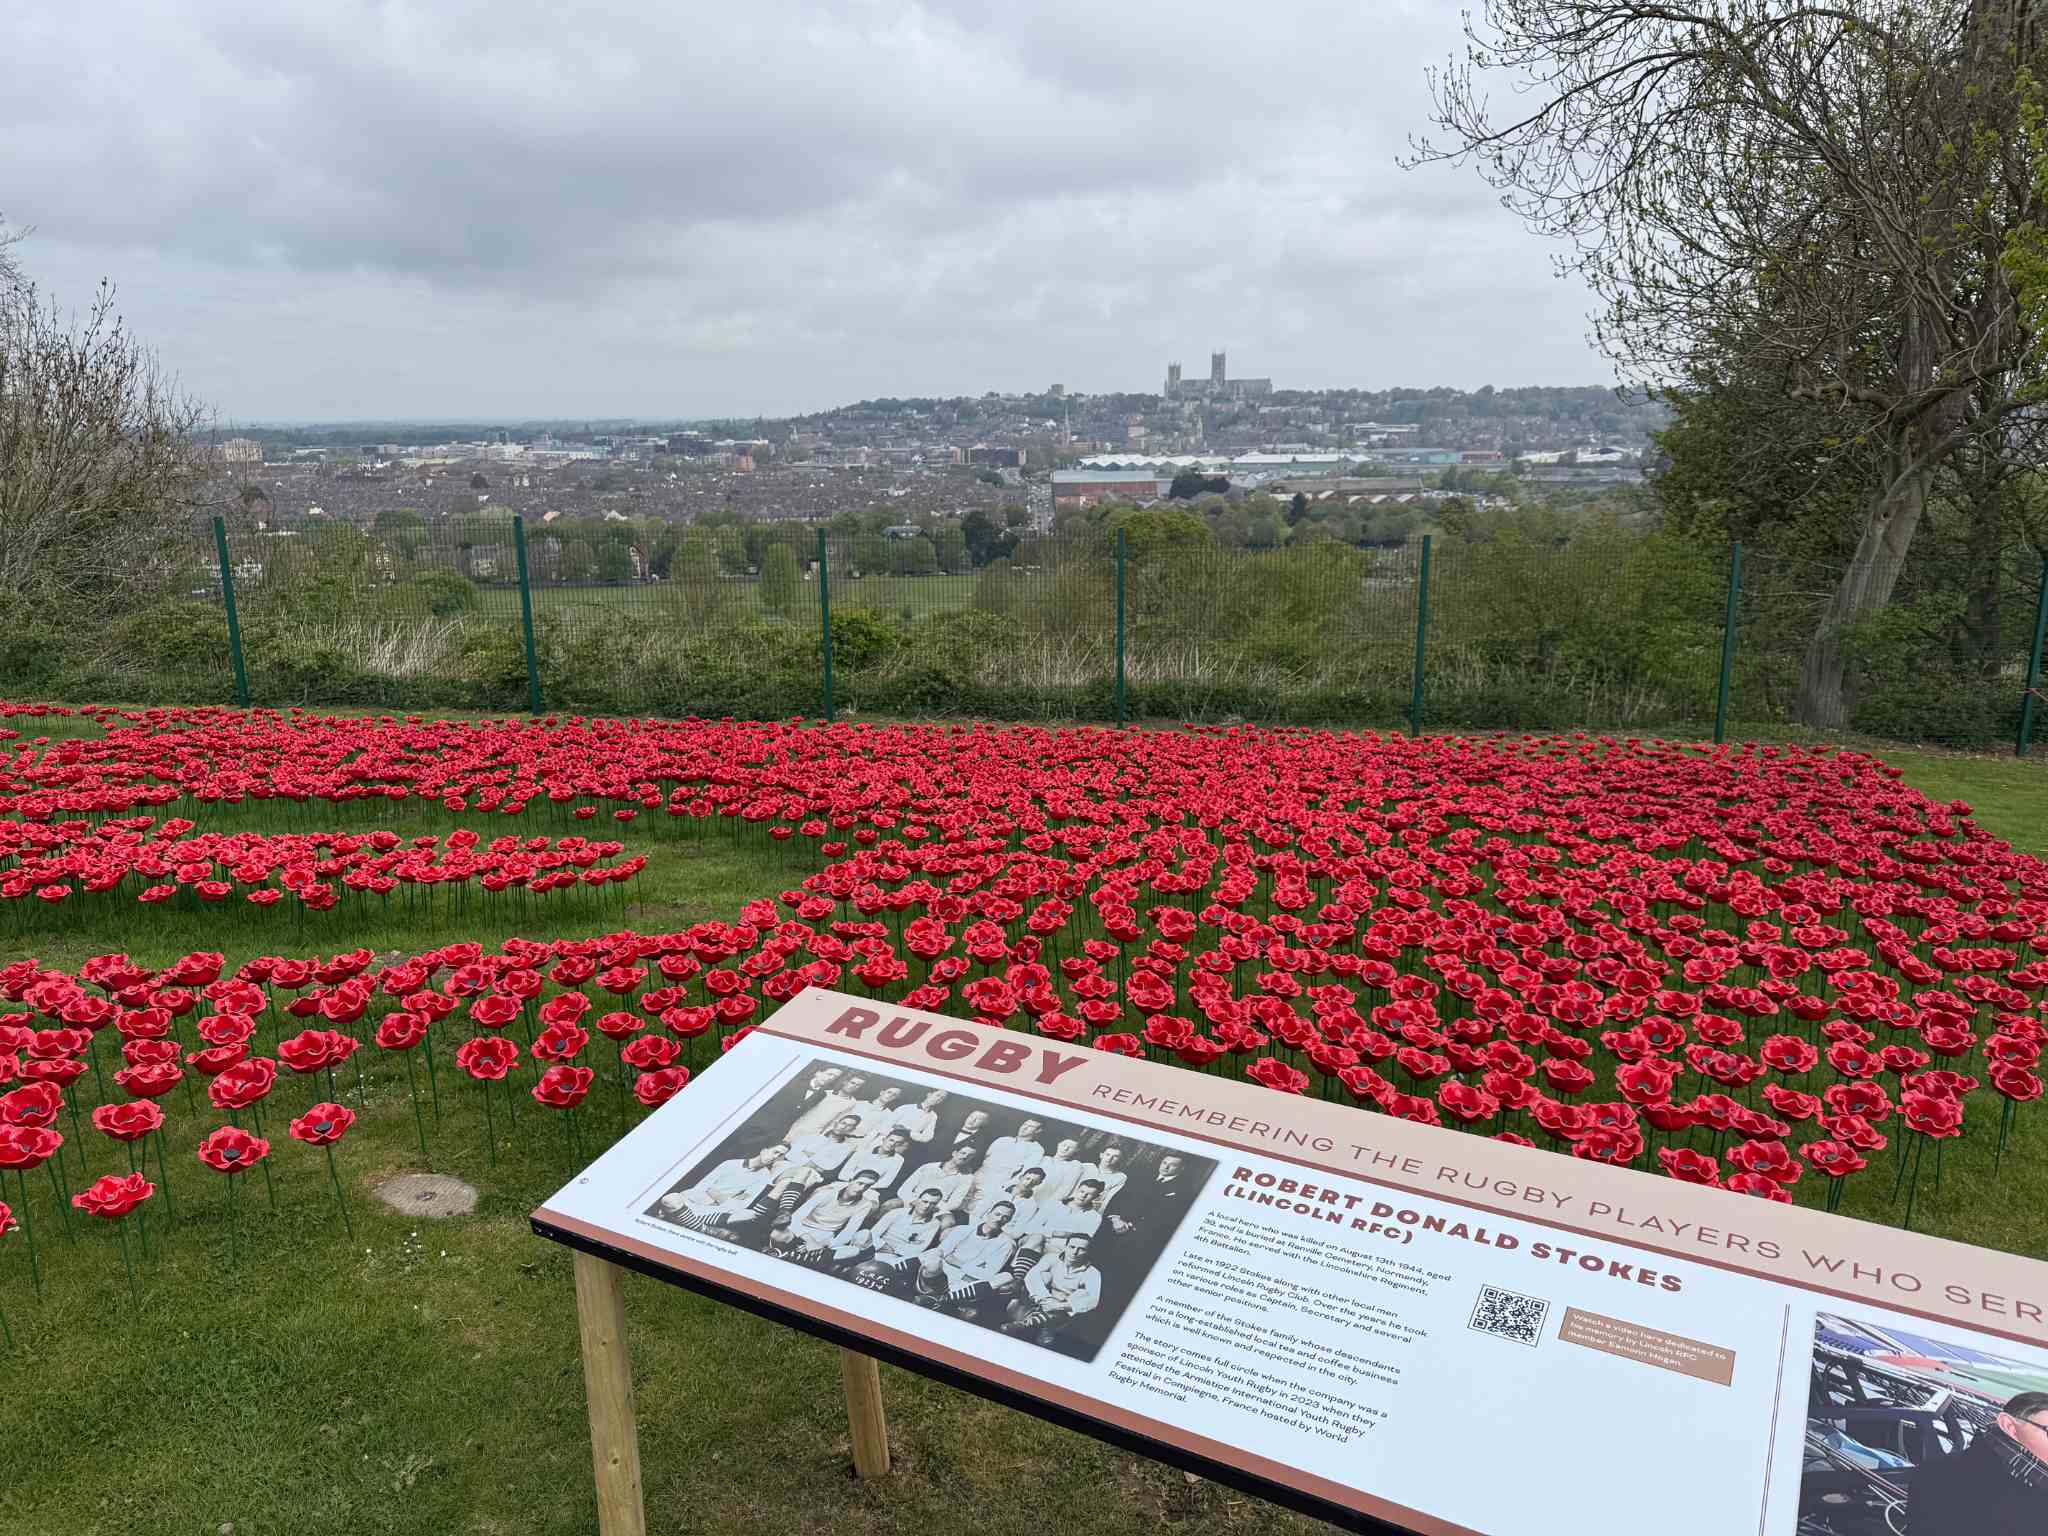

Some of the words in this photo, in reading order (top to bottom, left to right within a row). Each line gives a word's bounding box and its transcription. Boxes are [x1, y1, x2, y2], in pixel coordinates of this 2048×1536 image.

[823, 1006, 1089, 1086] RUGBY
[1091, 1084, 1334, 1152] REMEMBERING
[1351, 1144, 1424, 1175] THE
[1436, 1166, 1573, 1209] RUGBY
[1588, 1201, 1781, 1259] PLAYERS
[1801, 1249, 1922, 1293] WHO
[1944, 1284, 2043, 1324] SER
[1215, 1211, 1239, 1222] local
[1260, 1225, 1280, 1235] who
[1280, 1230, 1299, 1240] was
[1299, 1234, 1326, 1247] killed
[1324, 1243, 1338, 1251] on
[1338, 1246, 1373, 1261] August
[1374, 1255, 1396, 1267] 13th
[1425, 1270, 1452, 1282] aged
[1217, 1223, 1236, 1232] and
[1235, 1226, 1244, 1234] is
[1244, 1228, 1276, 1243] buried
[1274, 1238, 1286, 1247] at
[1222, 1182, 1344, 1225] (LINCOLN
[1350, 1217, 1413, 1245] RFC)
[1231, 1166, 1364, 1210] ROBERT
[1370, 1201, 1520, 1250] DONALD
[1530, 1242, 1682, 1292] STOKES
[1166, 1277, 1193, 1288] other
[1193, 1285, 1224, 1298] senior
[1182, 1249, 1203, 1262] Late
[1203, 1257, 1213, 1265] in
[1214, 1259, 1239, 1272] 1922
[1238, 1266, 1272, 1282] Stokes
[1272, 1277, 1299, 1291] along
[1300, 1285, 1321, 1296] with
[1321, 1292, 1350, 1304] other
[1350, 1297, 1376, 1311] local
[1232, 1235, 1247, 1245] He
[1247, 1241, 1282, 1254] served
[1281, 1249, 1301, 1260] with
[1301, 1255, 1319, 1265] the
[1319, 1259, 1378, 1282] Lincolnshire
[1155, 1294, 1163, 1302] A
[1163, 1296, 1204, 1313] member
[1203, 1309, 1217, 1317] of
[1215, 1312, 1233, 1323] the
[1233, 1317, 1268, 1334] Stokes
[1268, 1328, 1299, 1345] family
[1299, 1338, 1333, 1354] whose
[1333, 1348, 1401, 1374] descendants
[1171, 1268, 1184, 1277] on
[1185, 1272, 1219, 1287] various
[1218, 1282, 1245, 1294] roles
[1244, 1290, 1257, 1298] as
[1299, 1305, 1352, 1327] Secretary
[1351, 1321, 1373, 1332] and
[1373, 1328, 1412, 1344] several
[1176, 1259, 1222, 1277] reformed
[1220, 1271, 1255, 1287] Lincoln
[1255, 1281, 1286, 1297] Rugby
[1312, 1298, 1339, 1311] Over
[1338, 1306, 1356, 1317] the
[1357, 1313, 1387, 1326] years
[1387, 1319, 1402, 1330] he
[1403, 1325, 1428, 1337] took
[1107, 1369, 1139, 1388] Rugby
[1133, 1330, 1152, 1342] The
[1152, 1338, 1180, 1353] story
[1179, 1347, 1212, 1362] comes
[1213, 1355, 1230, 1368] full
[1229, 1363, 1259, 1377] circle
[1260, 1372, 1288, 1386] when
[1288, 1381, 1307, 1393] the
[1307, 1388, 1356, 1410] company
[1357, 1403, 1379, 1416] was
[1144, 1313, 1171, 1326] which
[1171, 1320, 1181, 1329] is
[1182, 1325, 1202, 1335] well
[1200, 1329, 1232, 1345] known
[1233, 1341, 1254, 1352] and
[1252, 1347, 1307, 1369] respected
[1306, 1362, 1317, 1372] in
[1317, 1366, 1336, 1378] the
[1149, 1303, 1167, 1313] run
[1174, 1309, 1254, 1341] long-established
[1252, 1334, 1278, 1348] local
[1277, 1343, 1295, 1354] tea
[1295, 1349, 1317, 1360] and
[1316, 1355, 1351, 1370] coffee
[1351, 1364, 1398, 1385] business
[1113, 1359, 1153, 1378] Festival
[1151, 1372, 1162, 1382] in
[1220, 1395, 1259, 1414] France
[1259, 1407, 1298, 1427] hosted
[1297, 1419, 1312, 1433] by
[1314, 1425, 1349, 1444] World
[1119, 1351, 1165, 1370] attended
[1163, 1365, 1181, 1376] the
[1180, 1370, 1230, 1392] Armistice
[1230, 1386, 1298, 1414] International
[1299, 1407, 1329, 1425] Youth
[1330, 1418, 1366, 1438] Rugby
[1126, 1341, 1166, 1358] sponsor
[1166, 1354, 1180, 1362] of
[1178, 1357, 1214, 1375] Lincoln
[1216, 1368, 1244, 1385] Youth
[1245, 1378, 1278, 1397] Rugby
[1278, 1389, 1289, 1399] in
[1289, 1393, 1320, 1409] 2023
[1321, 1404, 1350, 1419] when
[1350, 1413, 1376, 1429] they
